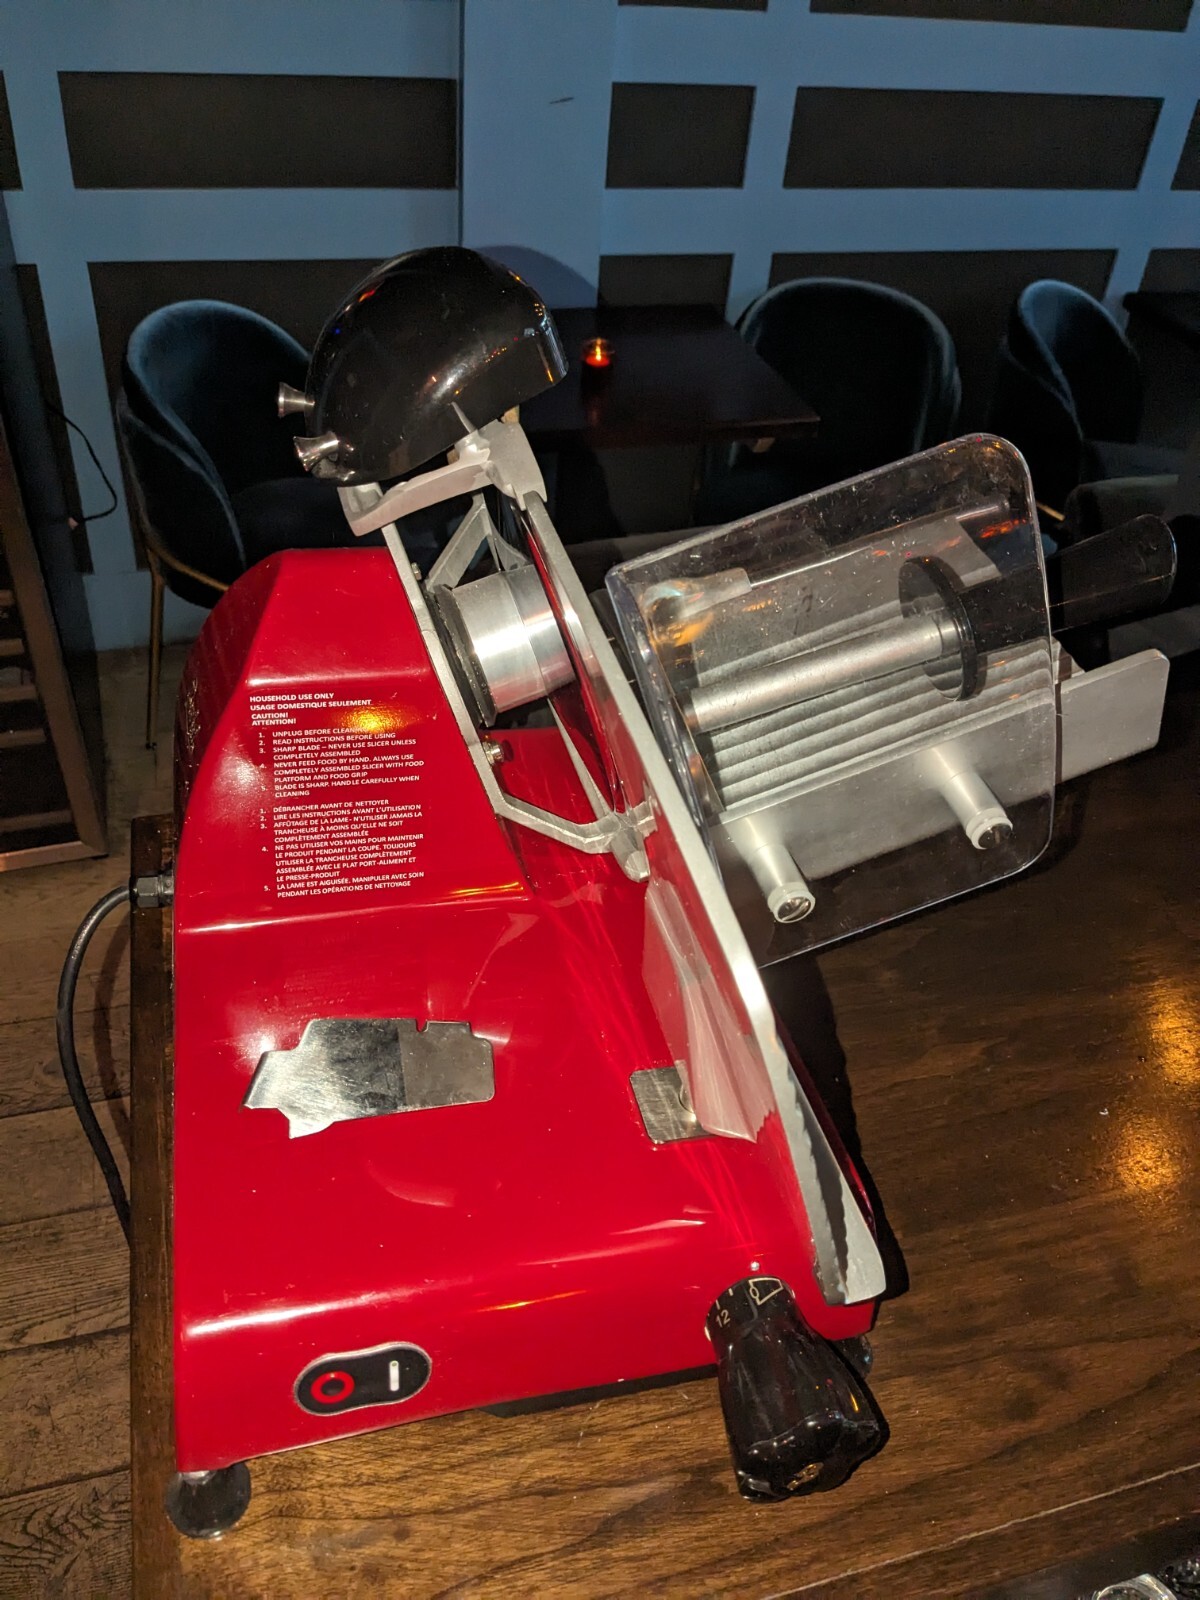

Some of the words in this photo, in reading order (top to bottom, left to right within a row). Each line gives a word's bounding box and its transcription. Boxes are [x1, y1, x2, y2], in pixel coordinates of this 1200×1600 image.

[250, 694, 296, 702] HOUSEHOLD
[278, 701, 327, 710] DOMESTIQUE
[294, 736, 344, 744] INSTRUCTIONS
[273, 752, 318, 760] COMPLETELY
[274, 767, 318, 775] COMPLETELY
[320, 764, 360, 772] ASSEMBLED
[302, 809, 350, 818] INSTRUCTIONS
[274, 827, 318, 836] TRANCHEUSE
[388, 833, 423, 842] MAINTENIR
[316, 847, 346, 855] PENDANT
[383, 842, 416, 850] TOUJOURS
[276, 858, 304, 866] UTILISER
[315, 854, 358, 863] TRANCHEUSE
[286, 870, 340, 881] PRESSE-PRODUIT
[352, 875, 389, 883] MANIPULER
[278, 890, 308, 898] PENDANT
[375, 881, 411, 890] NETTOYAGE
[716, 1309, 730, 1328] 12
